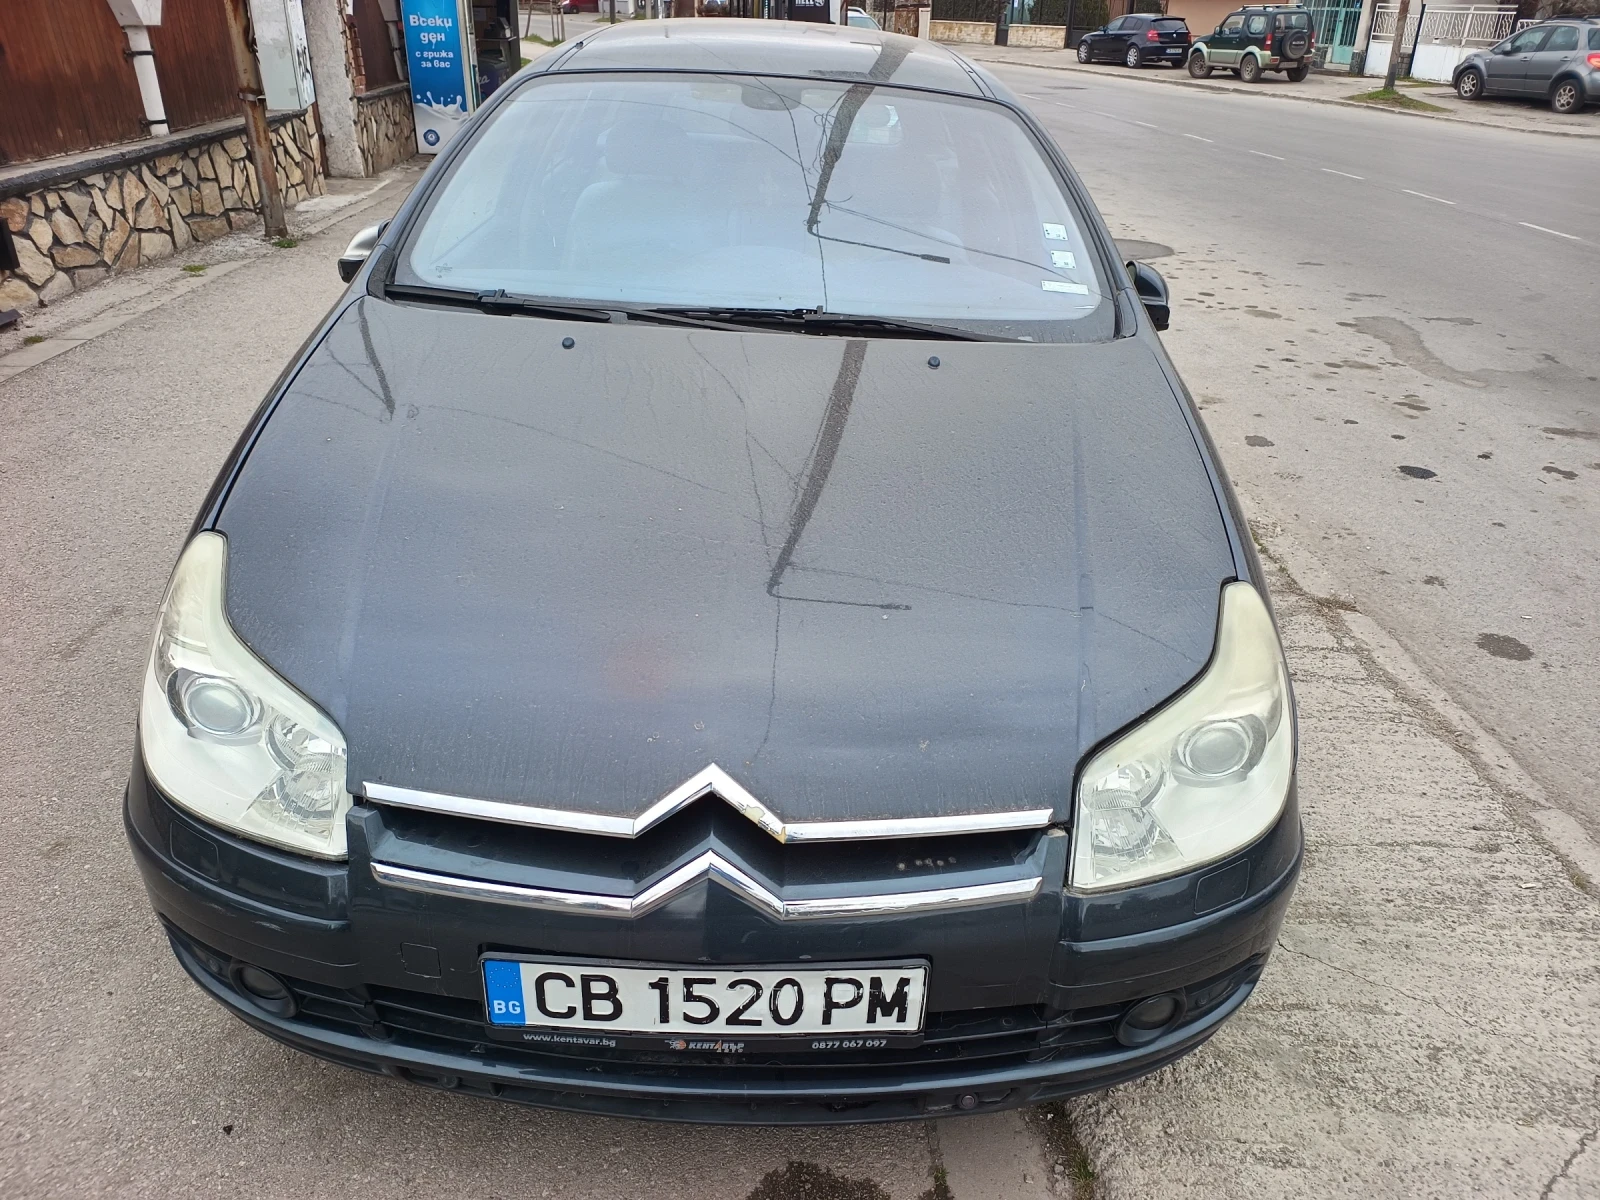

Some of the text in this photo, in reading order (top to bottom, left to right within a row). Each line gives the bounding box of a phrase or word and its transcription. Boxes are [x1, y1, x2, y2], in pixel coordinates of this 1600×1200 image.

[409, 15, 452, 29] Всеки
[420, 32, 446, 44] ден
[423, 50, 453, 59] грижа
[434, 60, 451, 68] вас
[534, 971, 911, 1026] CB 1520 PM
[493, 999, 521, 1014] BG
[523, 1033, 616, 1047] www.kentavar.bg
[811, 1039, 887, 1049] 0877 067 097
